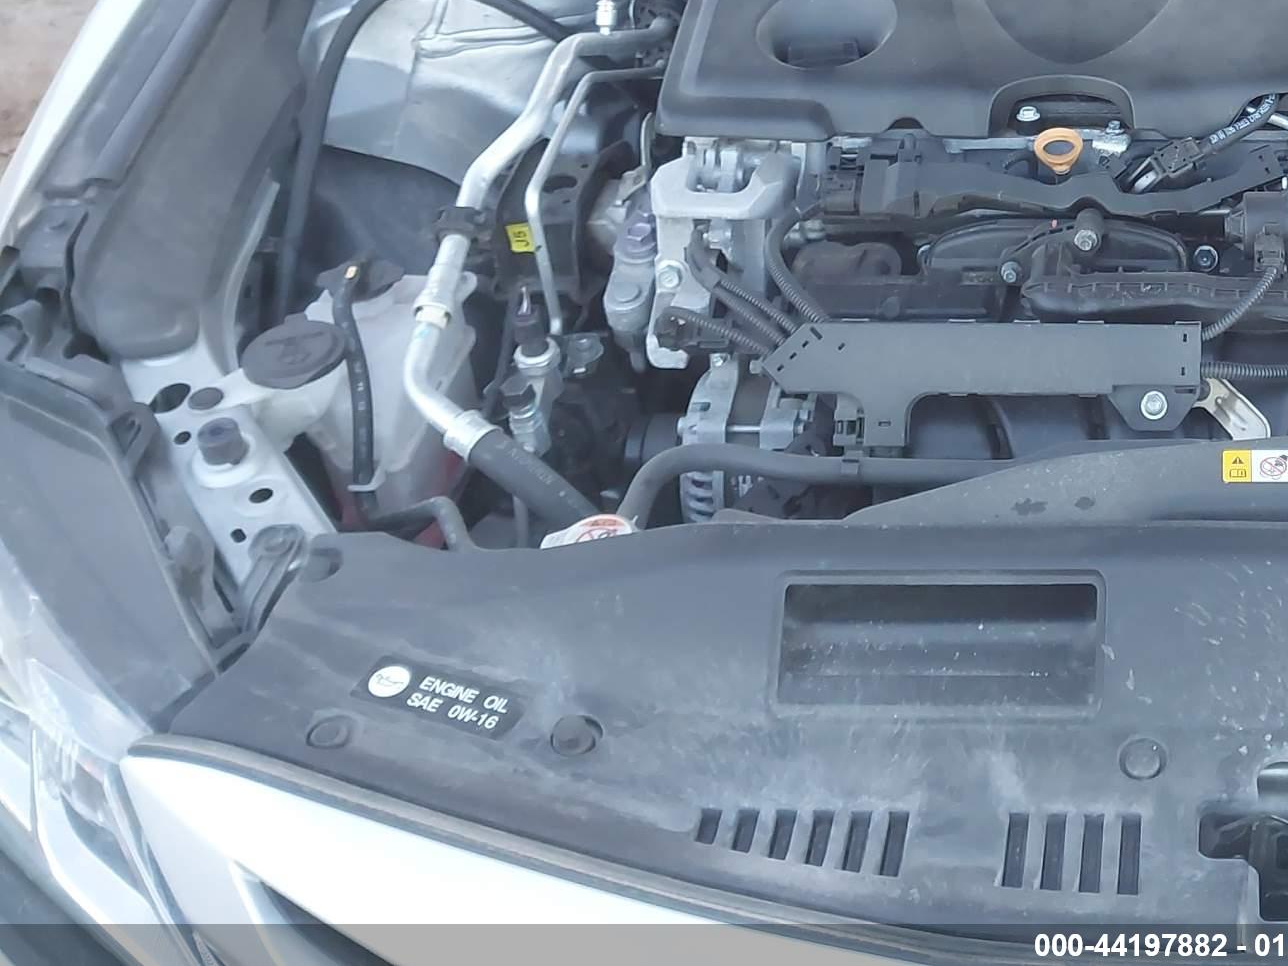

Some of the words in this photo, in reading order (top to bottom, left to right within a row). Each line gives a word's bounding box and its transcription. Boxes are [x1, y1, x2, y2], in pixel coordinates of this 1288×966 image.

[406, 692, 443, 712] SAE
[447, 705, 499, 729] 0W-16
[419, 676, 479, 703] ENGINE
[483, 695, 508, 713] OIL
